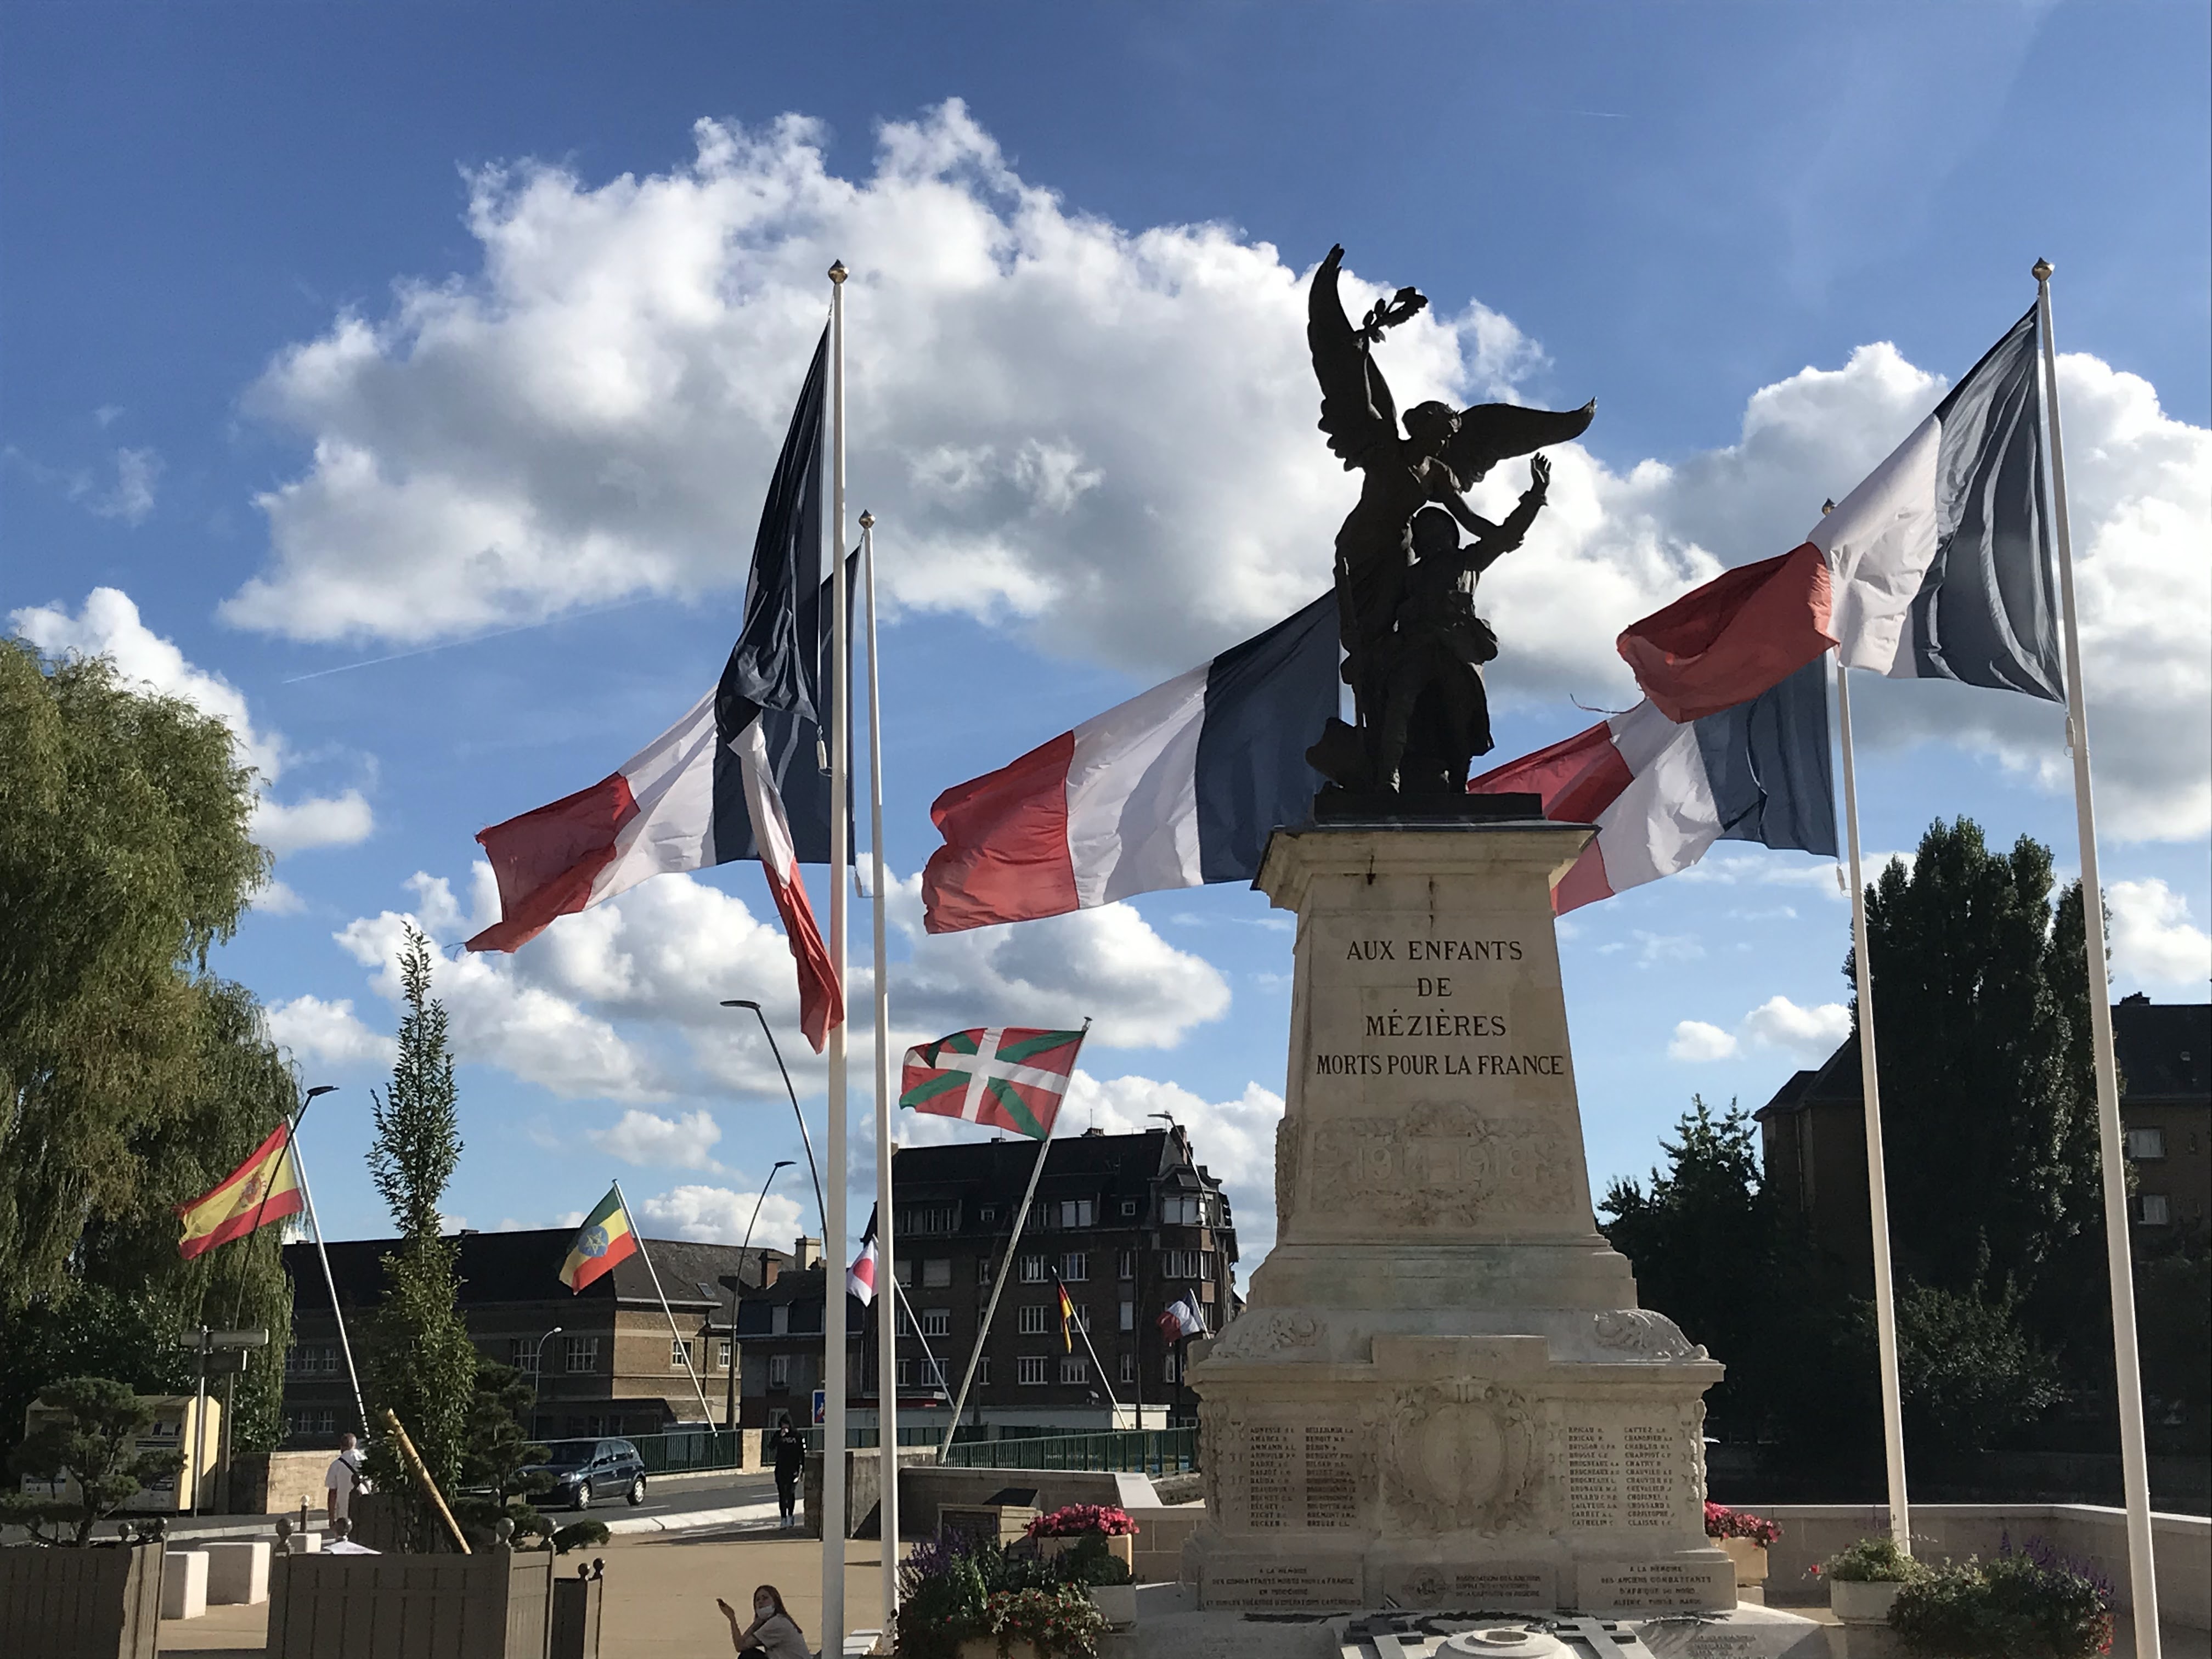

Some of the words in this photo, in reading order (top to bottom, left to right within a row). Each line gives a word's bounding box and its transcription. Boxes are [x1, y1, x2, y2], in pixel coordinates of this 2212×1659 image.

[1346, 940, 1395, 961] AUX
[1408, 940, 1523, 961] ENFANTS
[1417, 977, 1453, 997] DE
[1365, 1008, 1507, 1036] MÉZIÈRES
[1316, 1054, 1382, 1075] MORTS
[1387, 1055, 1440, 1075] POUR
[1444, 1055, 1472, 1075] LA
[1477, 1055, 1564, 1075] FRANCE
